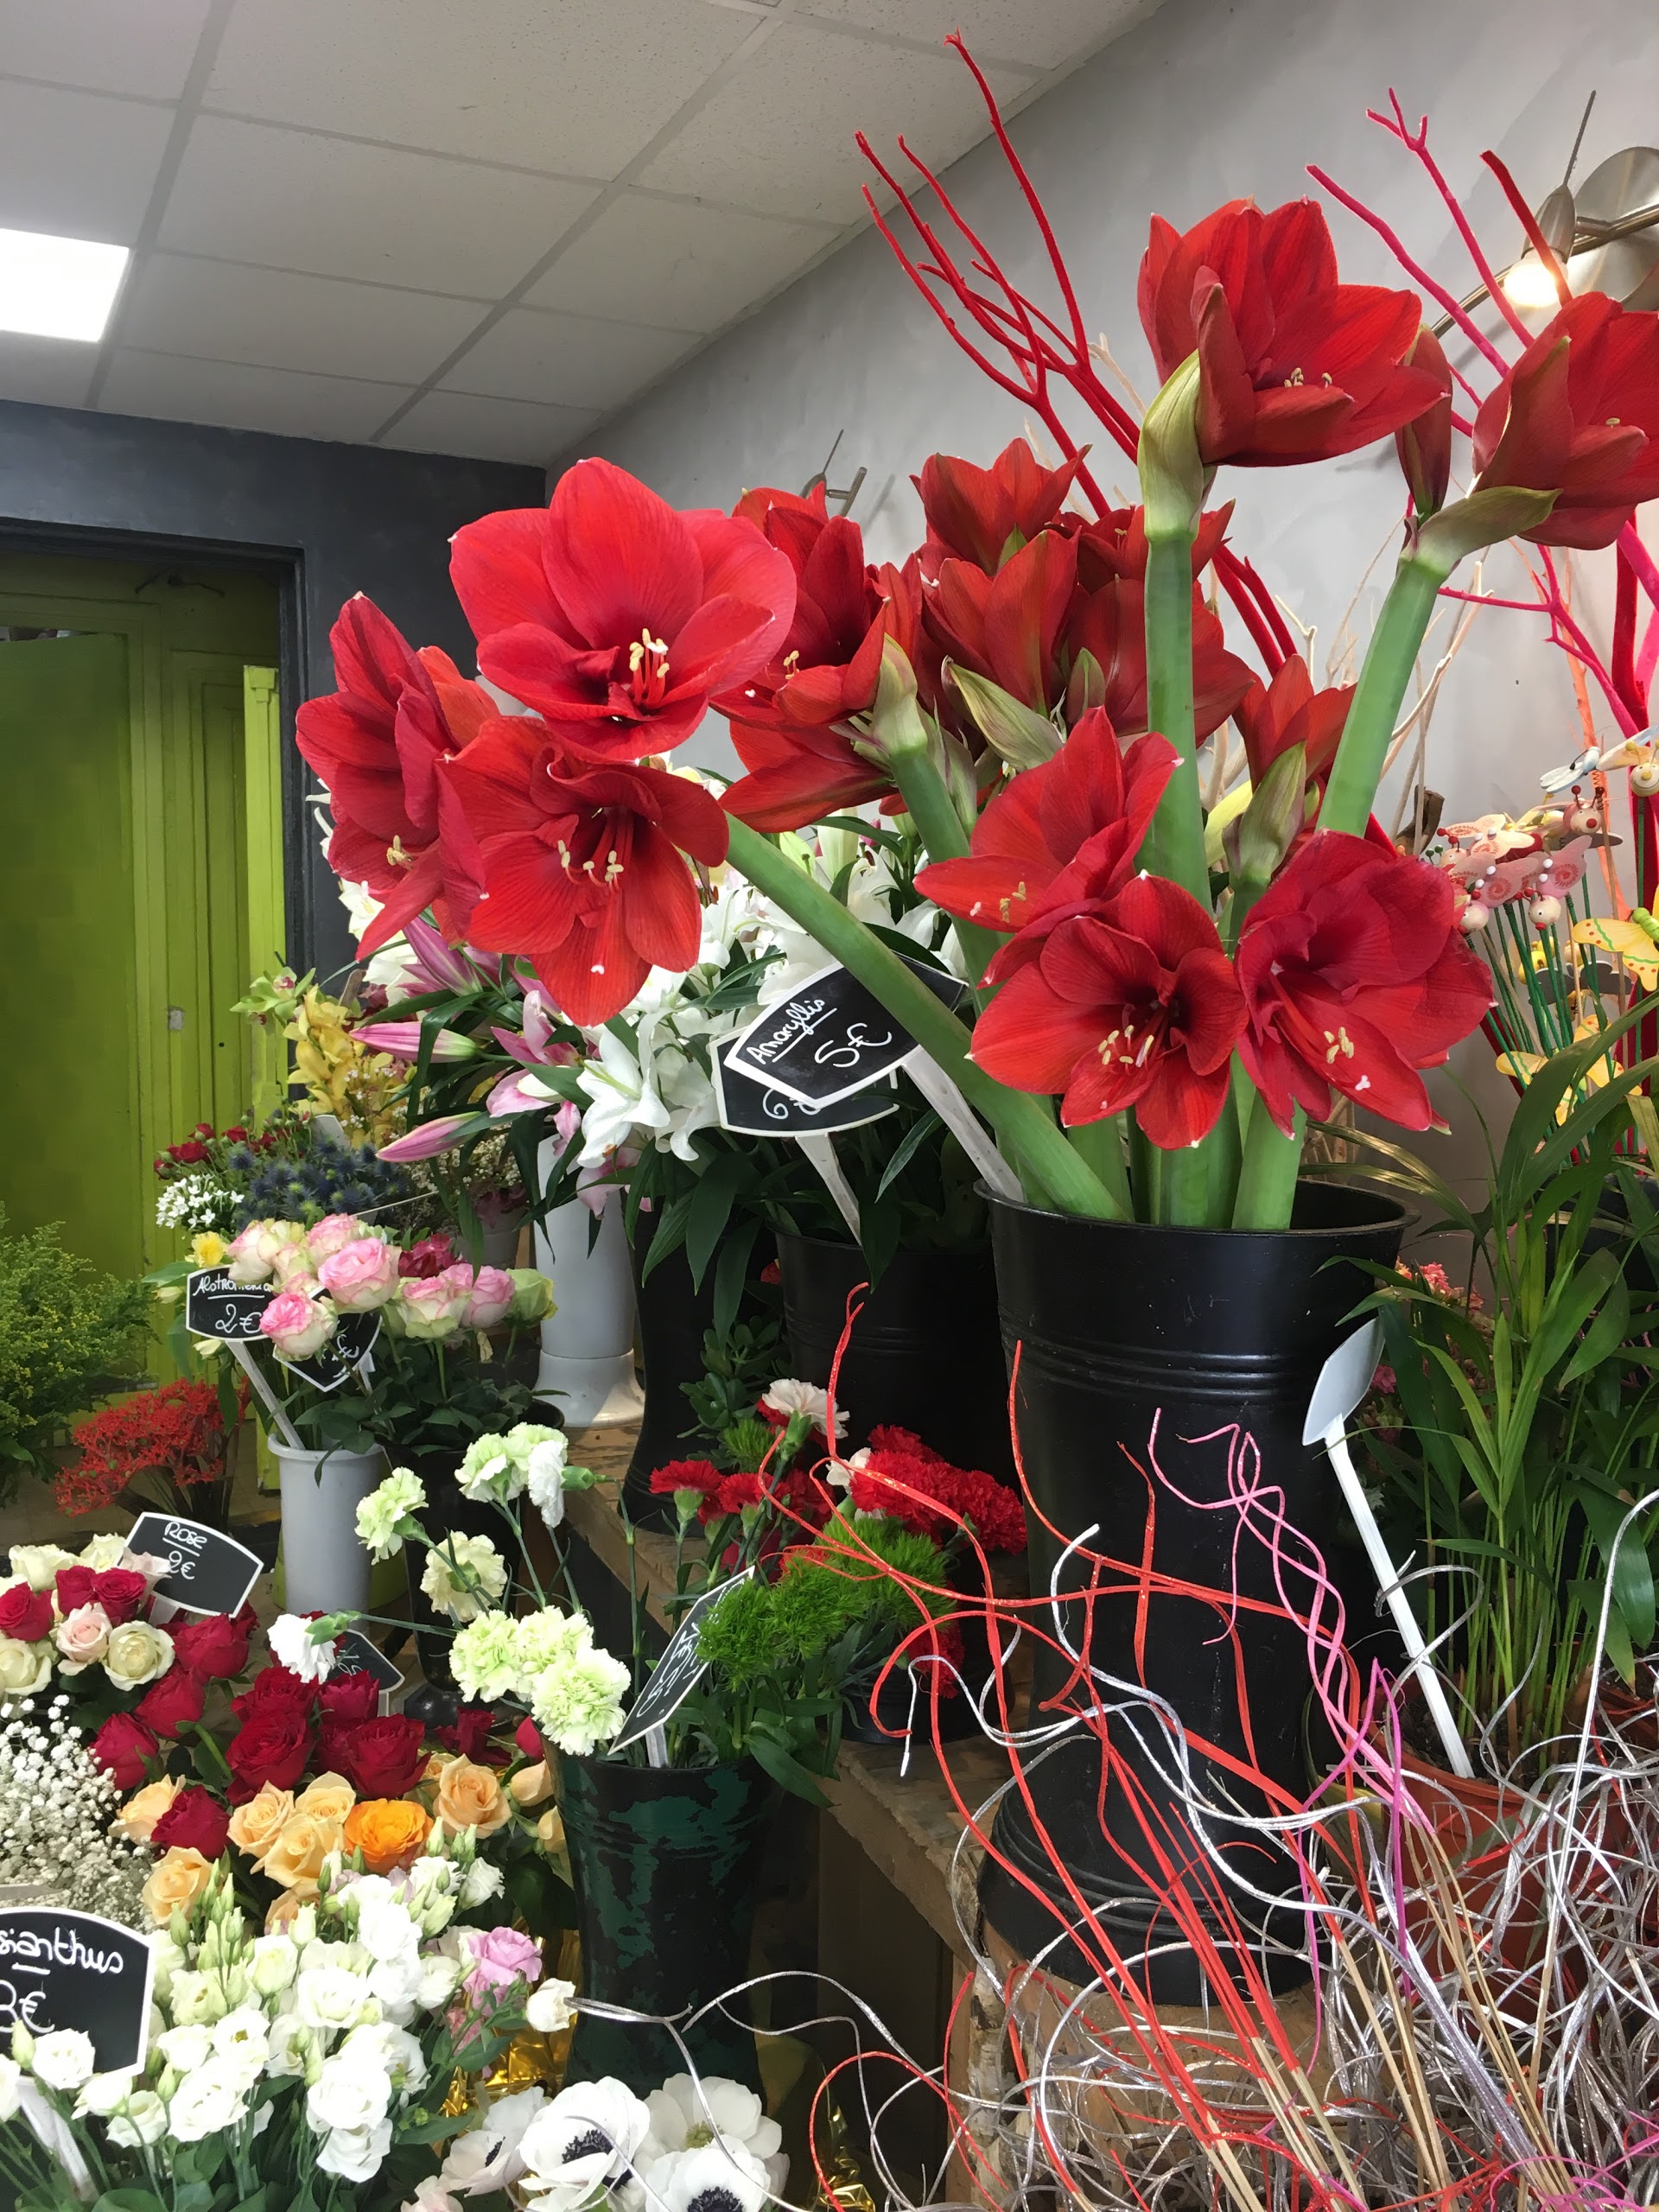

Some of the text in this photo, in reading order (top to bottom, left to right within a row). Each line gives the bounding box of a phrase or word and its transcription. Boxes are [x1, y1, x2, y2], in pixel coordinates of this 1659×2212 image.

[747, 1000, 825, 1065] Amaryllis
[215, 1303, 263, 1334] 2€
[164, 1522, 208, 1549] Rose
